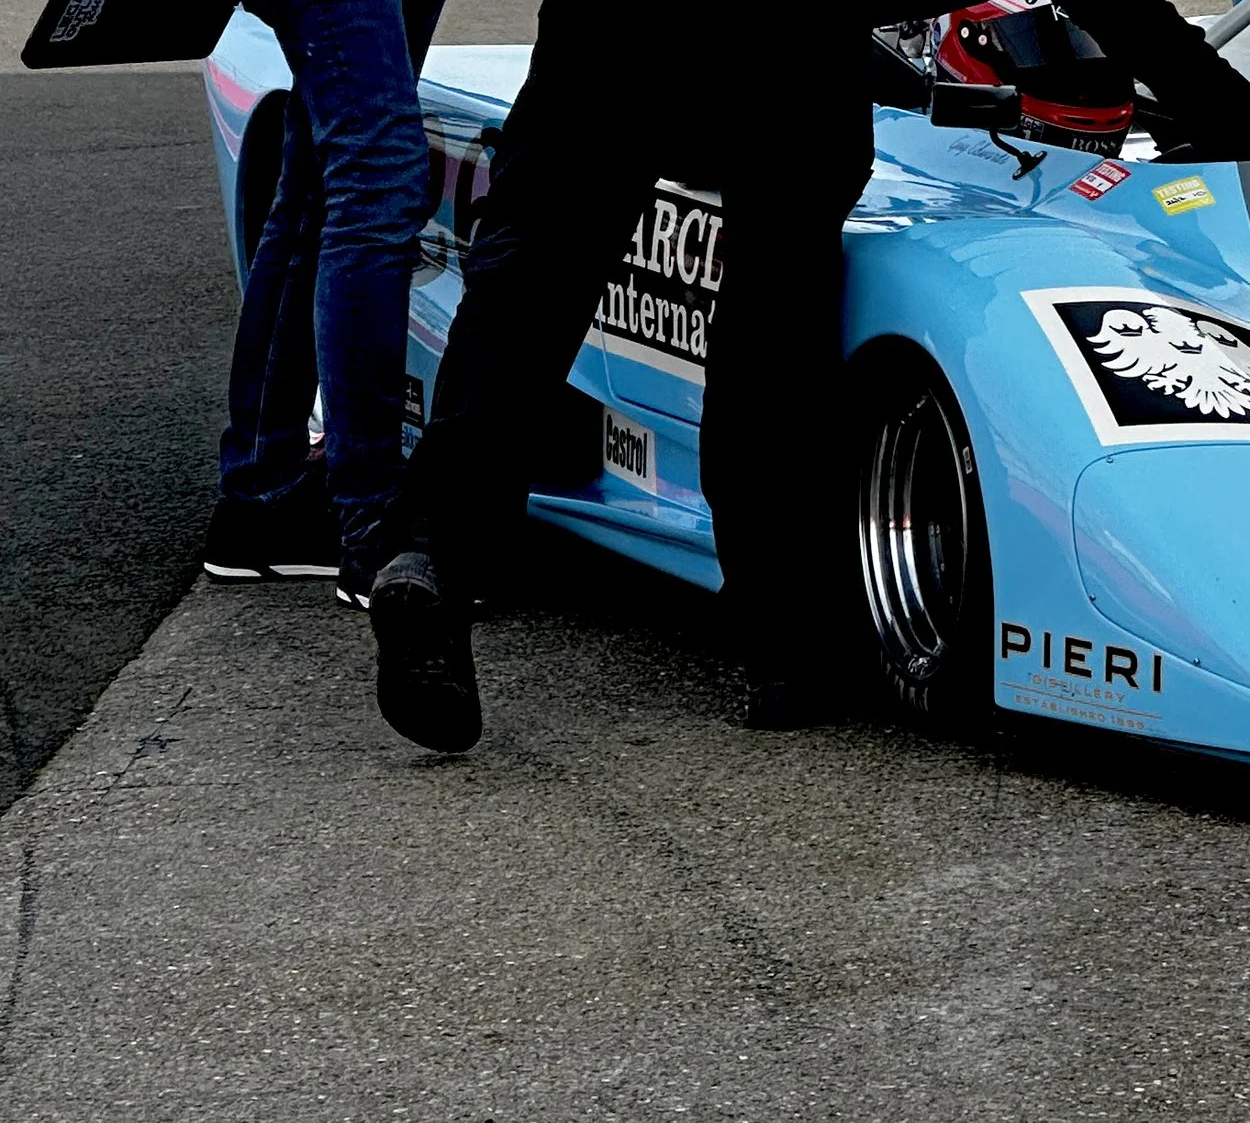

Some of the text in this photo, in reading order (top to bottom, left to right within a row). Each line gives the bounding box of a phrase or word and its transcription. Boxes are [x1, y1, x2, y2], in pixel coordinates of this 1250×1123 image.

[606, 414, 647, 478] Castrol
[1001, 622, 1162, 693] PIERI
[1015, 694, 1105, 722] ESTABLISHED
